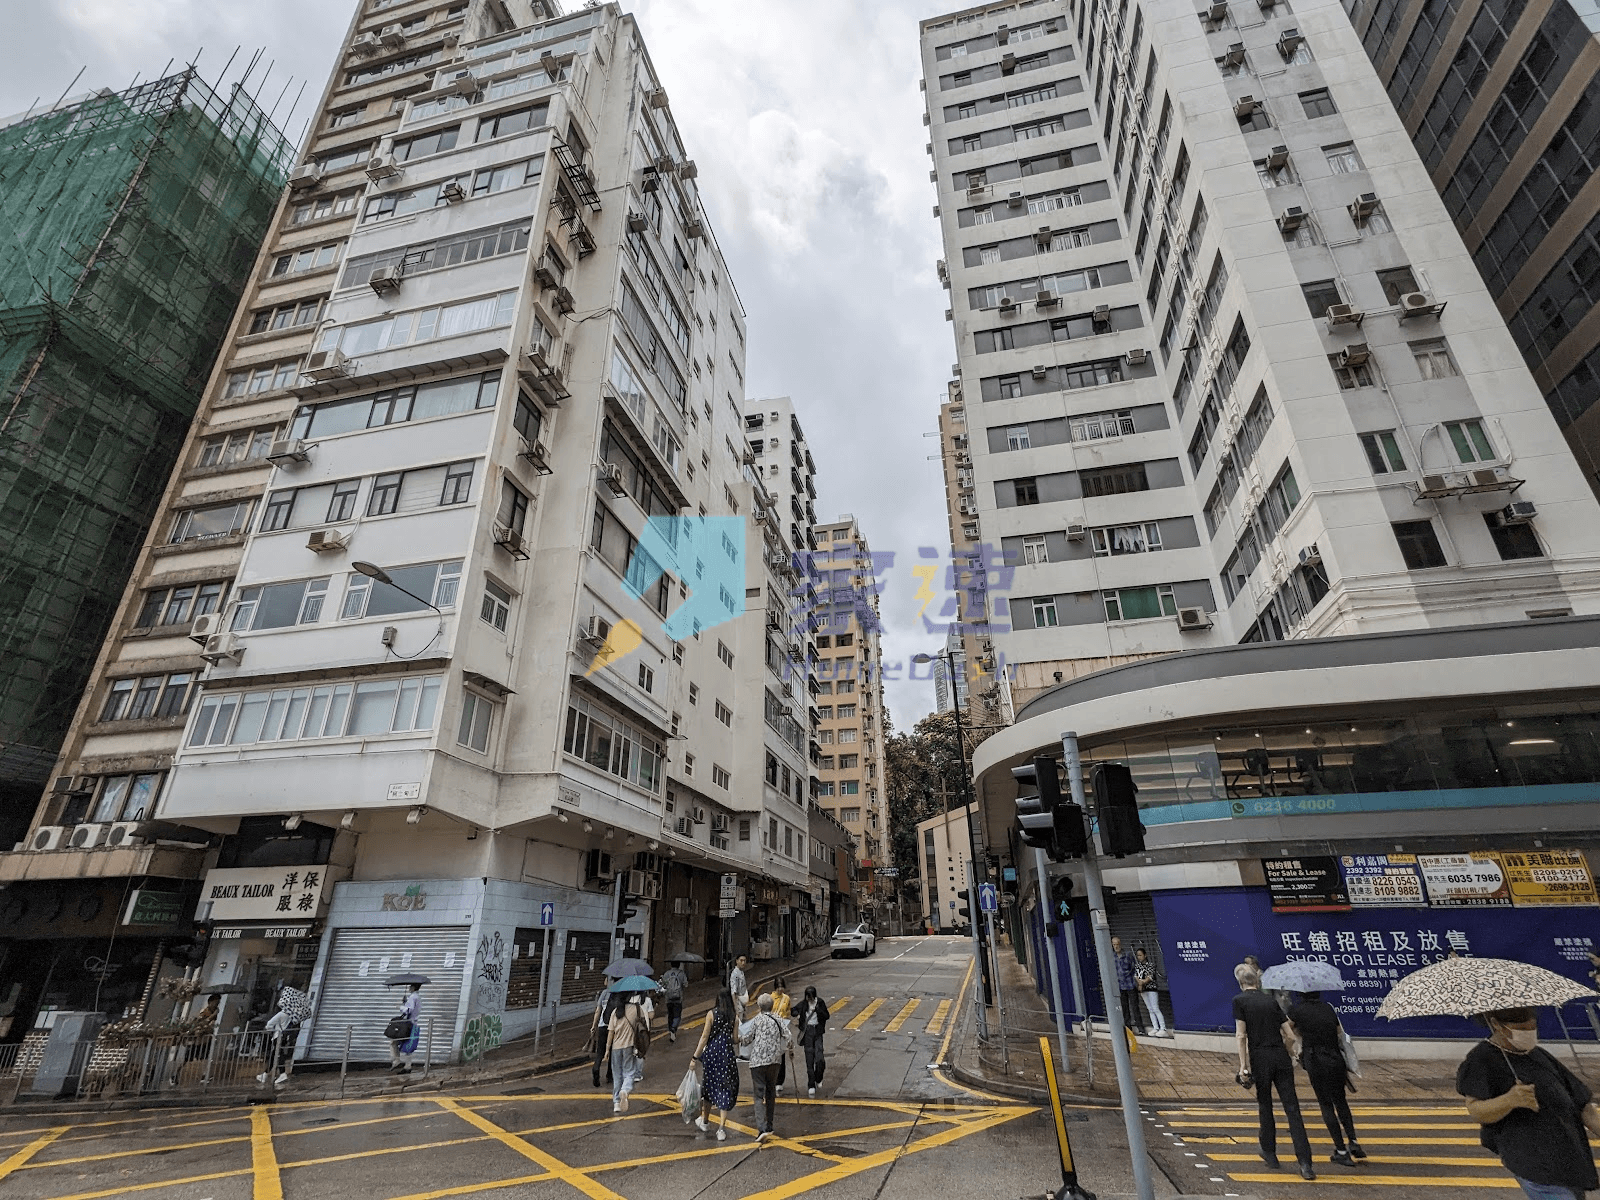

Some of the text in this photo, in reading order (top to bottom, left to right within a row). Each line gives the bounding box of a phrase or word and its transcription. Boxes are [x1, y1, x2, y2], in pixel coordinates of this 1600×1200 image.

[1299, 799, 1336, 810] 4000
[1372, 877, 1418, 886] 8226 0543
[1447, 873, 1501, 883] 6035 7986
[210, 884, 275, 899] BEAUX TAILOR
[1374, 886, 1420, 896] 8109 9882
[221, 929, 242, 939] TAILOR
[264, 928, 285, 938] BEAUX
[285, 928, 307, 938] TAILOR
[1332, 954, 1365, 966] FOR
[1368, 953, 1417, 966] LEASE
[1421, 953, 1431, 966] &
[1357, 995, 1384, 1004] querie
